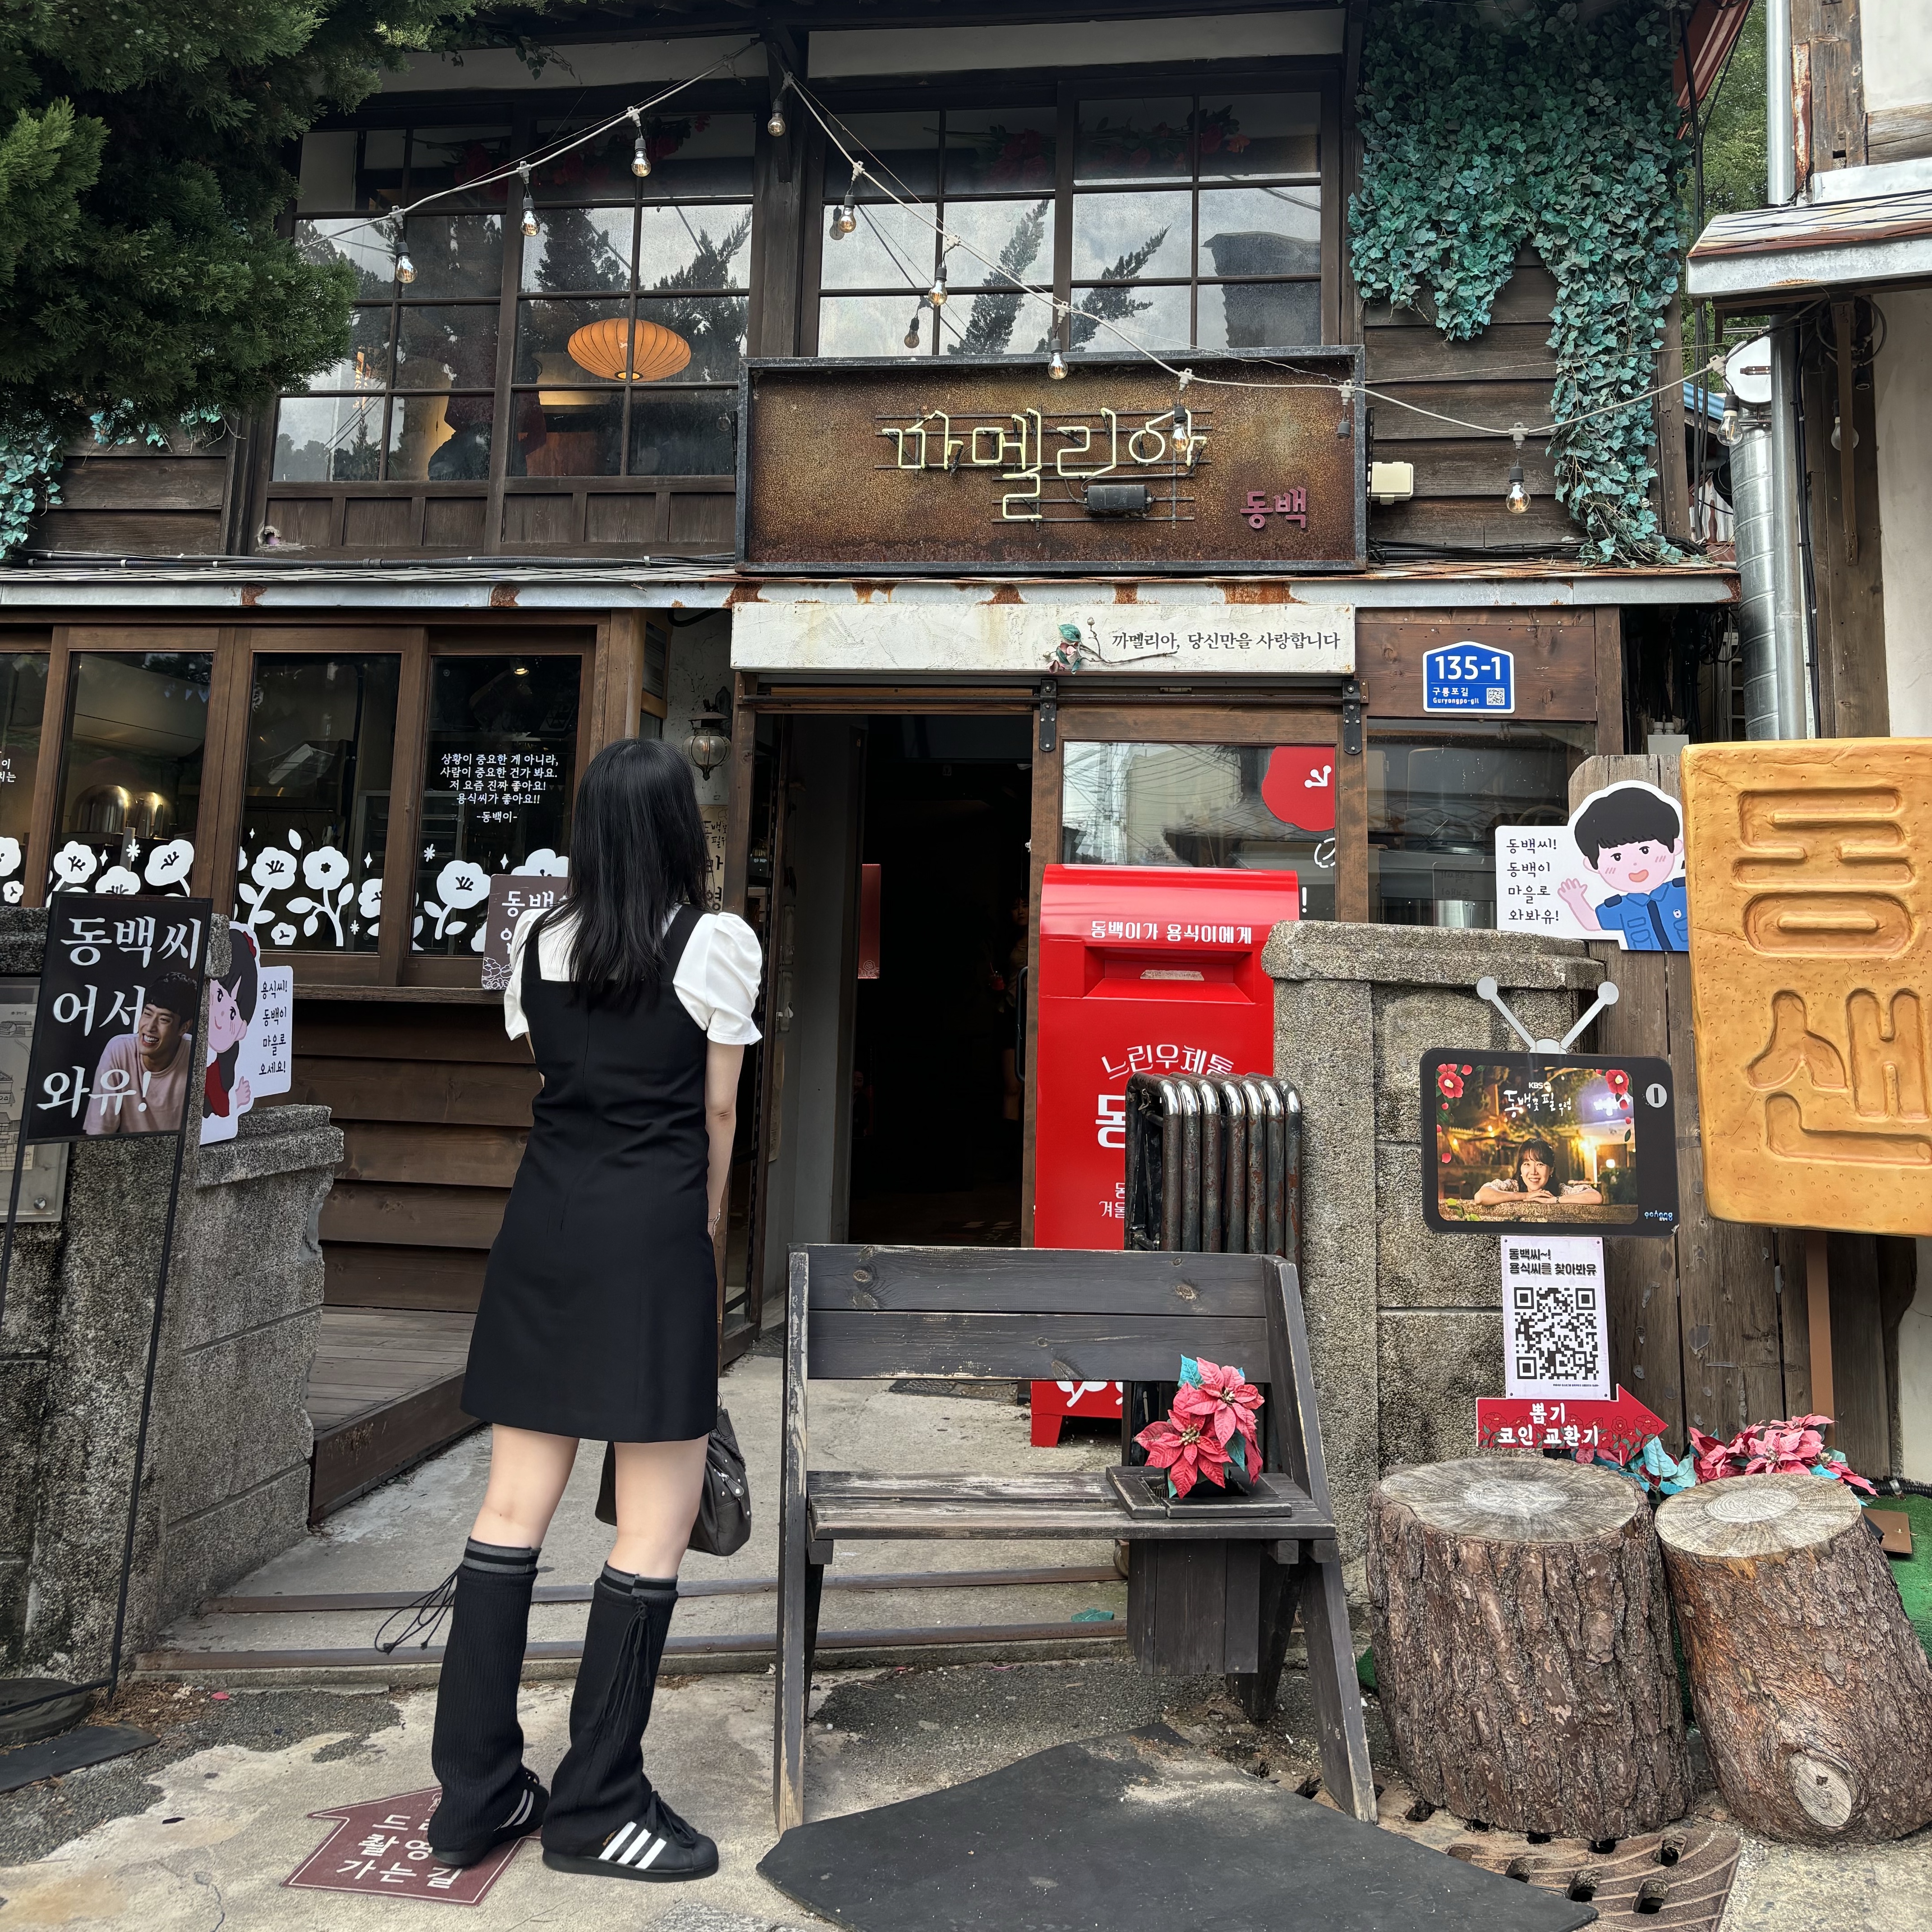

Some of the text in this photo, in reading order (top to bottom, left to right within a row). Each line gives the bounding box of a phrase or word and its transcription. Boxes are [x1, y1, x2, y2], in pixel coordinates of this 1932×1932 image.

[1240, 487, 1308, 529] 동백
[1187, 631, 1253, 650] 당신만을
[1255, 631, 1341, 650] 사랑합니다
[1435, 655, 1501, 680] 135-1
[1432, 687, 1469, 697] 구룡포길
[441, 754, 559, 767] 상황이 중요한 게 아니라,
[440, 767, 558, 779] 사람이 중요한 건가 봐요.
[449, 781, 546, 792] 저 요즘 진짜 좋아요!
[456, 793, 540, 805] 용식씨가 좋아요!!
[476, 811, 517, 823] -동백이-
[1506, 837, 1557, 854] 동백씨!
[1507, 861, 1550, 878] 동백이
[1508, 884, 1551, 904] 마을로
[1508, 909, 1559, 925] 와봐유!
[1091, 920, 1253, 945] 동백이가 용식이에게
[60, 916, 202, 969] 동백씨
[260, 980, 288, 999] 용식씨!
[53, 984, 146, 1037] 어서
[262, 1006, 287, 1027] 동백이
[262, 1033, 286, 1056] 마을로
[258, 1061, 286, 1076] 오세요!
[37, 1066, 152, 1118] 와유!
[1554, 1263, 1597, 1276] 찾아봐유
[1529, 1402, 1566, 1424] 뽑기
[1497, 1424, 1599, 1448] 코인 교환기
